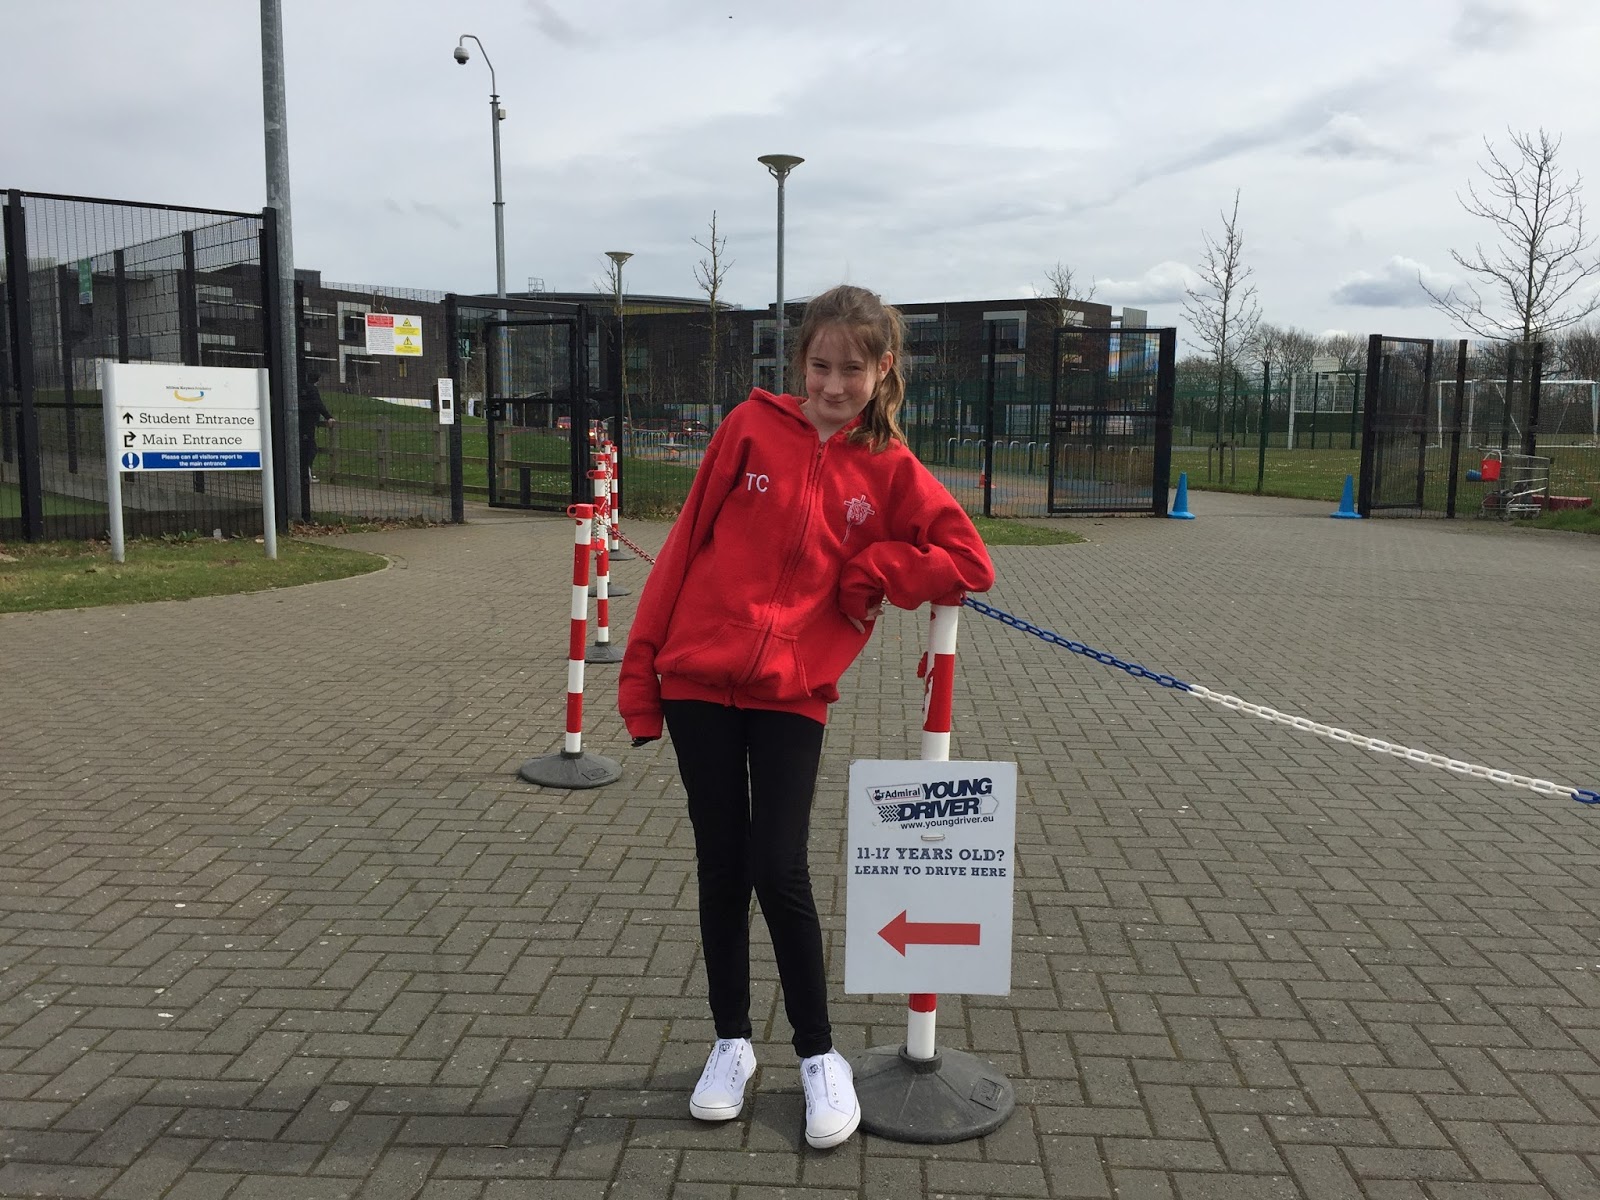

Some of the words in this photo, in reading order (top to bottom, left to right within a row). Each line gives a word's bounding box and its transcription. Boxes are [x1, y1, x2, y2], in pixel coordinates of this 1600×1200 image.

[139, 412, 191, 425] Student
[195, 413, 255, 426] Entrance
[142, 433, 178, 446] Main
[182, 433, 243, 446] Entrance
[219, 454, 236, 462] report
[745, 472, 770, 493] TC
[884, 787, 921, 799] Admiral
[922, 777, 993, 800] YOUNG
[898, 797, 980, 821] DRIVER
[900, 815, 995, 830] www.youngdriver.eu
[857, 847, 891, 860] 11-17
[896, 847, 953, 860] YEARS
[958, 848, 1005, 862] OLD?
[854, 865, 899, 875] LEARN
[903, 866, 921, 875] TO
[925, 866, 967, 876] DRIVE
[970, 867, 1007, 878] HERE
